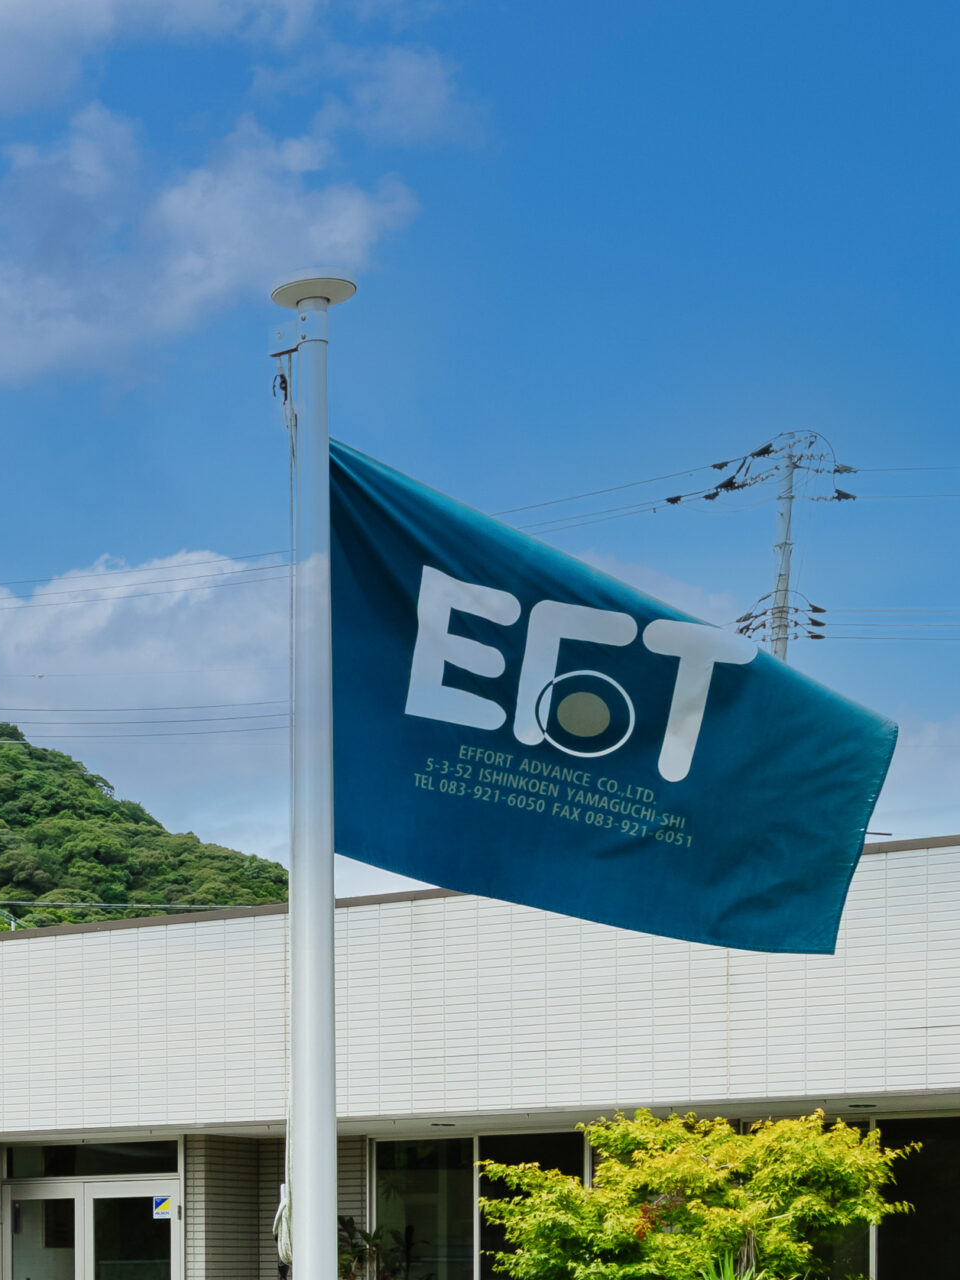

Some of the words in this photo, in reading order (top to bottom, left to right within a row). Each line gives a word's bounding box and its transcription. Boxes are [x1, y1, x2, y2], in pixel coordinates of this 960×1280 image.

[414, 773, 435, 790] TEL
[439, 779, 546, 813] 083-921-6050
[552, 802, 581, 821] FAX
[585, 811, 693, 848] 083-921-6051
[425, 757, 473, 779] 5-3-52
[479, 768, 560, 798] ISHINKOEN
[567, 787, 686, 829] YAMAGUCHI-SHI
[459, 745, 514, 769] EFFORT
[519, 758, 591, 787] ADVANCE
[597, 777, 657, 805] CO.,LTD.
